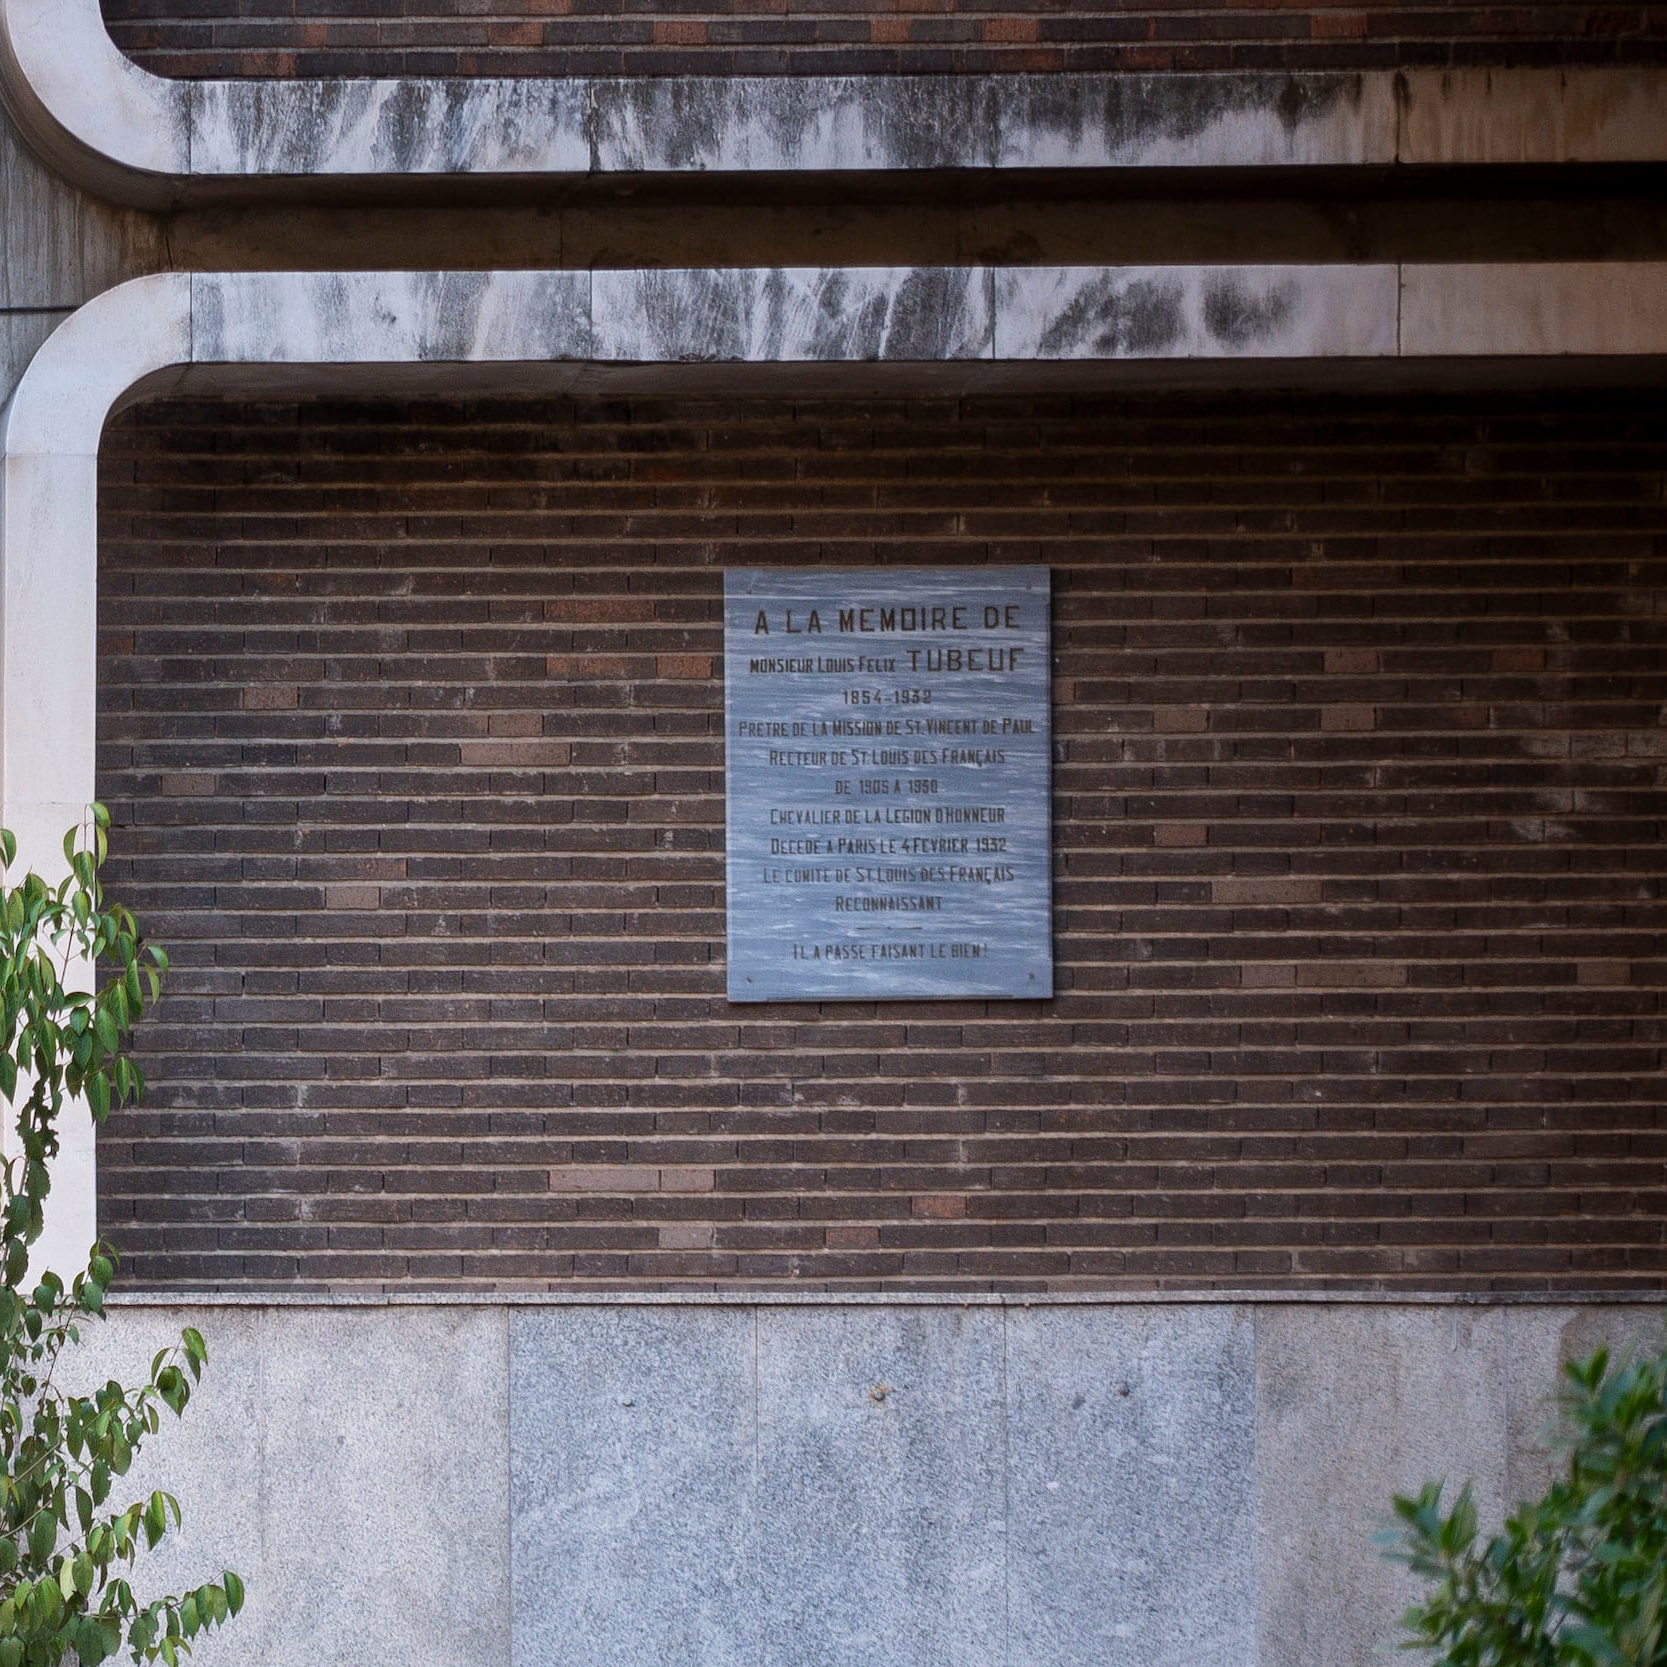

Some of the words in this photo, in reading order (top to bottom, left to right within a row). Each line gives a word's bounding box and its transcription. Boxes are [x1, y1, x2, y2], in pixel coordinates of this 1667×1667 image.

[755, 610, 769, 634] A
[786, 608, 821, 633] LA
[839, 607, 967, 633] MEMOIRE
[984, 606, 1020, 629] DE
[750, 658, 813, 673] MONSIEUR
[906, 647, 1024, 672] TUBEUF
[793, 722, 808, 737] DE
[813, 722, 828, 737] LA
[886, 720, 901, 736] DE
[982, 720, 998, 735] DE
[831, 751, 846, 766] DE
[770, 808, 840, 825] CHEVALIER
[844, 809, 861, 824] DE
[865, 809, 881, 824] LA
[838, 837, 876, 854] PARIS
[880, 839, 897, 854] LE
